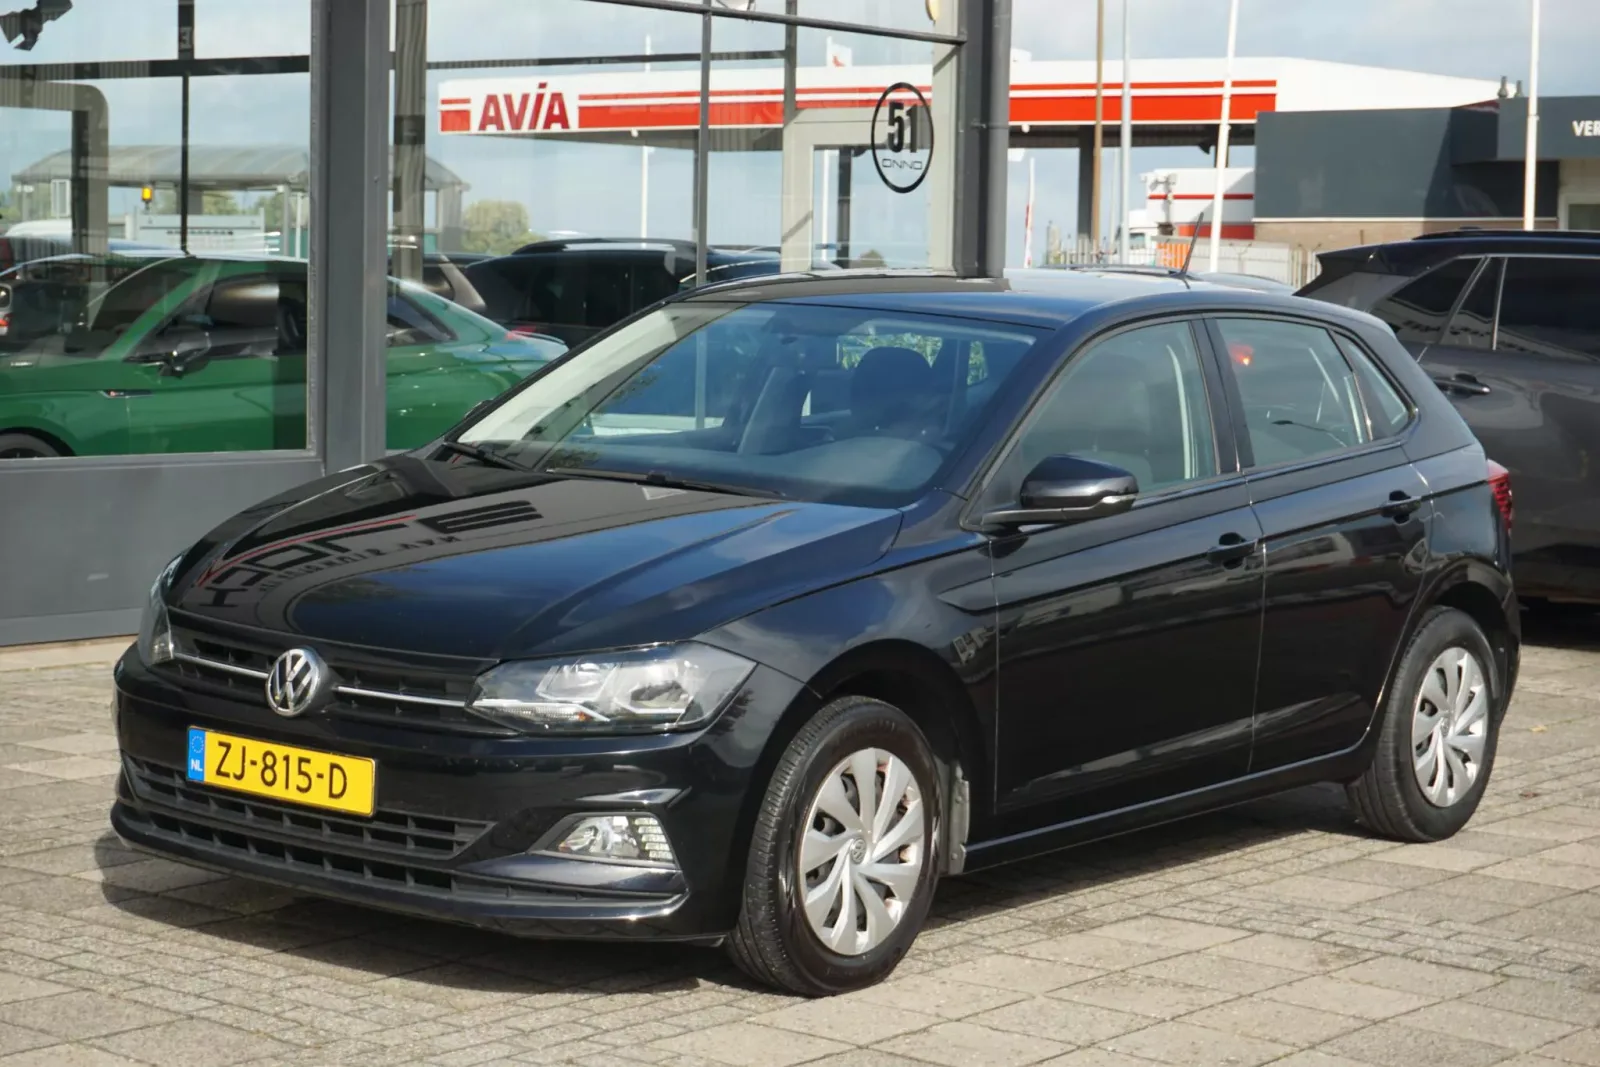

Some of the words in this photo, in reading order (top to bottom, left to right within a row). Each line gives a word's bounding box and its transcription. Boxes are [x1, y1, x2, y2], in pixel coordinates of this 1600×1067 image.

[887, 100, 918, 153] 51
[881, 158, 923, 171] ONNO
[190, 758, 203, 772] NL
[215, 740, 348, 800] ZJ-815-D
